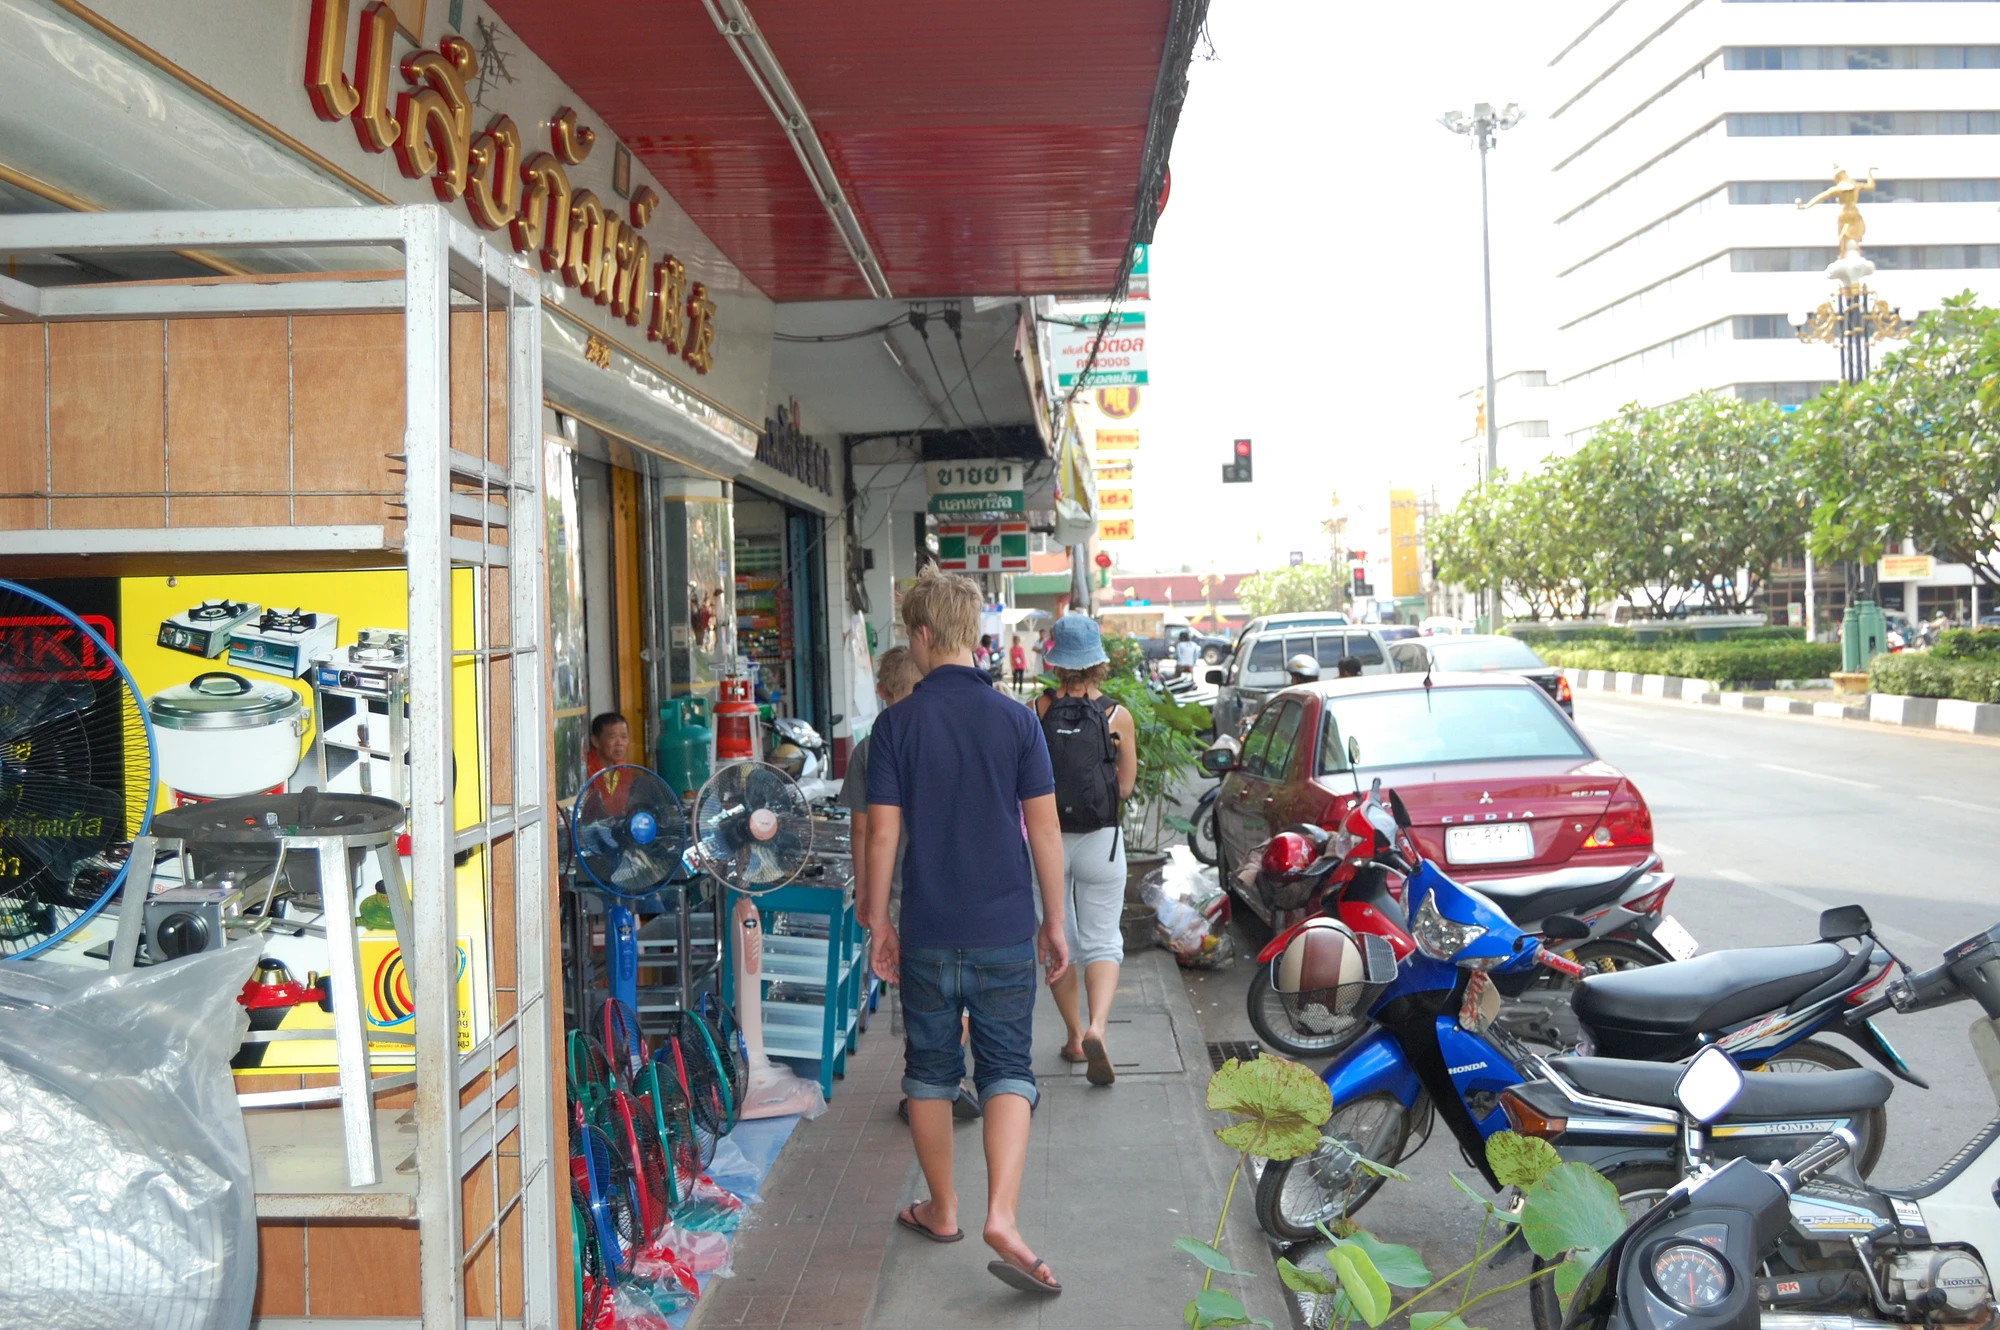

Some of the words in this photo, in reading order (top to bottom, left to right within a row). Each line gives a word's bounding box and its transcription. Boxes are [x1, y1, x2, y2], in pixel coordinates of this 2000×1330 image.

[937, 465, 1012, 486] ขายยา
[968, 524, 998, 569] 7
[1441, 811, 1534, 823] CEDIA
[1448, 1061, 1488, 1075] HONDA
[1765, 1122, 1824, 1134] HONDA
[1798, 1215, 1873, 1225] DREAM
[1777, 1281, 1799, 1293] RK
[1943, 1278, 1982, 1287] HONDA
